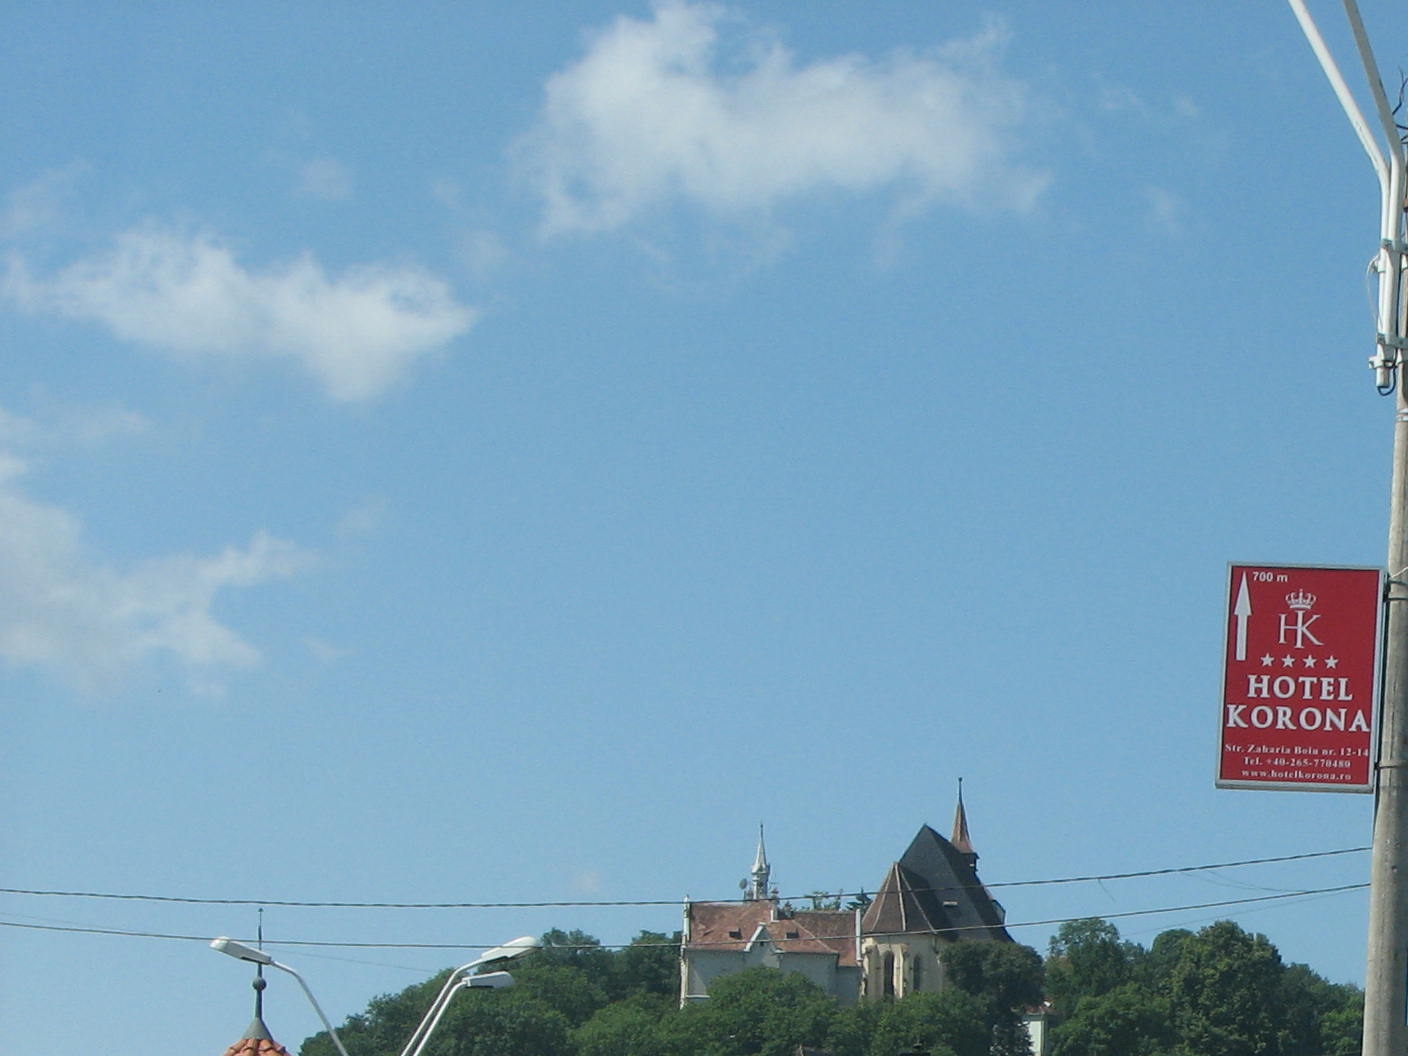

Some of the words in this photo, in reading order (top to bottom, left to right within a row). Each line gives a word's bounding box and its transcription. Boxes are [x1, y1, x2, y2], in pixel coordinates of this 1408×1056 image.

[1252, 571, 1275, 582] 700
[1276, 574, 1289, 583] m
[1278, 609, 1324, 649] HK
[1247, 674, 1353, 701] HOTEL
[1226, 704, 1371, 732] KORONA
[1224, 743, 1244, 753] Str.
[1247, 744, 1291, 755] Zaharia
[1243, 756, 1263, 766] Tel.
[1241, 769, 1352, 781] www.hotelkorona.ro
